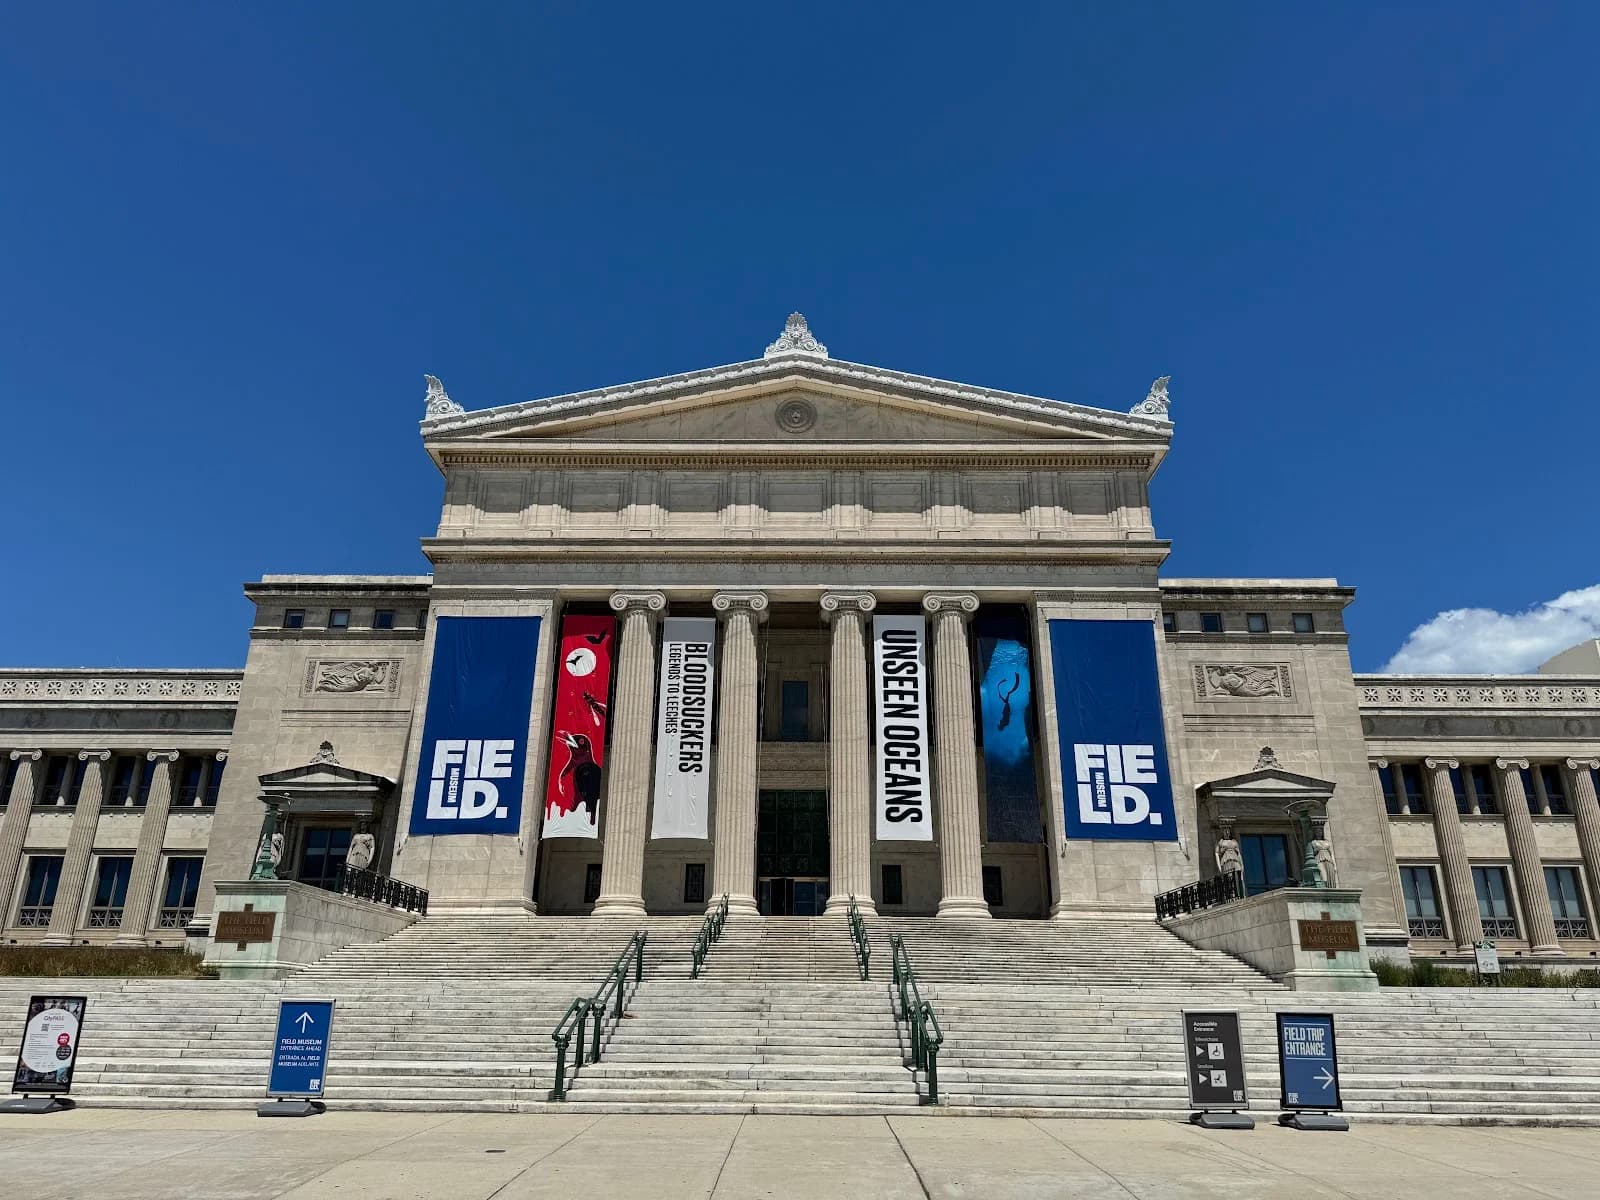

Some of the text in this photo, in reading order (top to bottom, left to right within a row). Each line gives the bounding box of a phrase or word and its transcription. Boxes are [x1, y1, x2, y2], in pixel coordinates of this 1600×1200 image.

[665, 643, 682, 734] LEGENDS TO LEECHES
[678, 643, 708, 773] BLOODSUCKERS
[881, 629, 923, 823] UNSEEN OCEANS
[447, 767, 461, 803] MUSEUM
[1095, 772, 1107, 808] MUSEUM
[1304, 924, 1352, 934] THE FIELD
[1309, 935, 1351, 945] MUSEUM
[1284, 1027, 1325, 1041] FIELD TRIP
[1285, 1042, 1327, 1056] ENTRANCE
